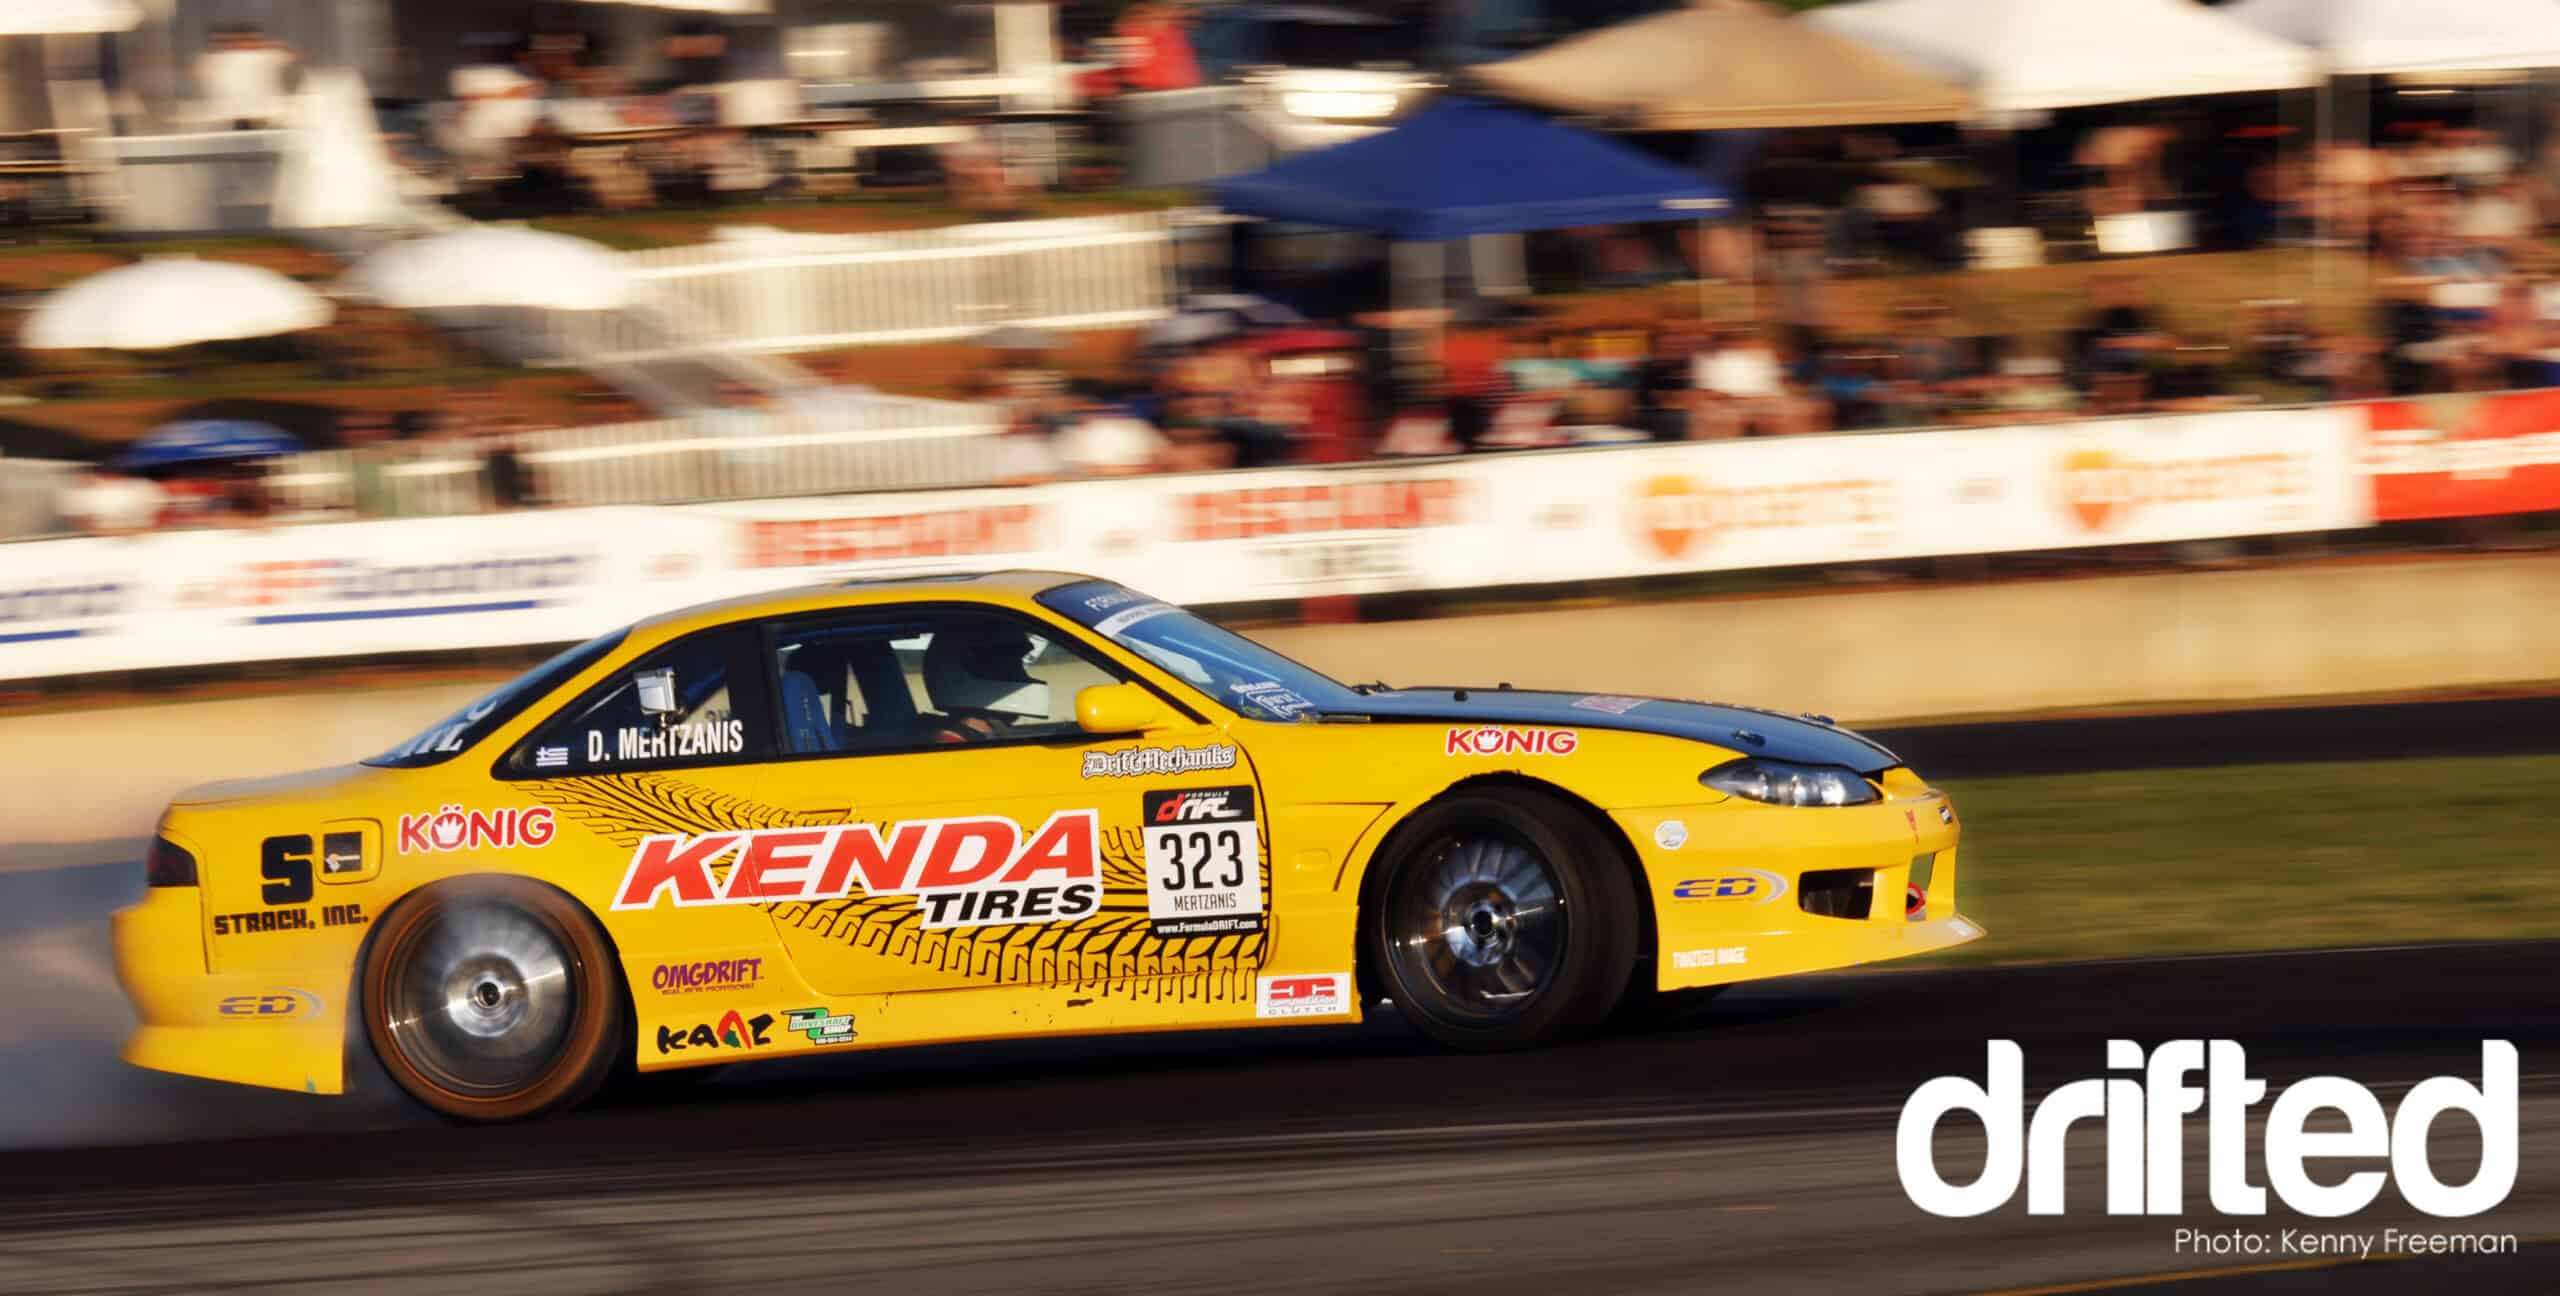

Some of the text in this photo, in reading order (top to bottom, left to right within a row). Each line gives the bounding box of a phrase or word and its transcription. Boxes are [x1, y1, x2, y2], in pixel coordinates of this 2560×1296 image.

[588, 720, 743, 762] D. MERTZANIS
[1448, 726, 1577, 754] KÖNIG
[400, 805, 556, 852] KÖNIG
[261, 834, 313, 905] S
[614, 810, 1098, 908] KENDA
[1160, 830, 1244, 890] 323
[924, 883, 1097, 924] TIRES
[1174, 892, 1237, 912] MERTZANIS
[1156, 919, 1259, 934] www.FormulaDRIFT.com
[653, 957, 763, 989] OMGDRIFT
